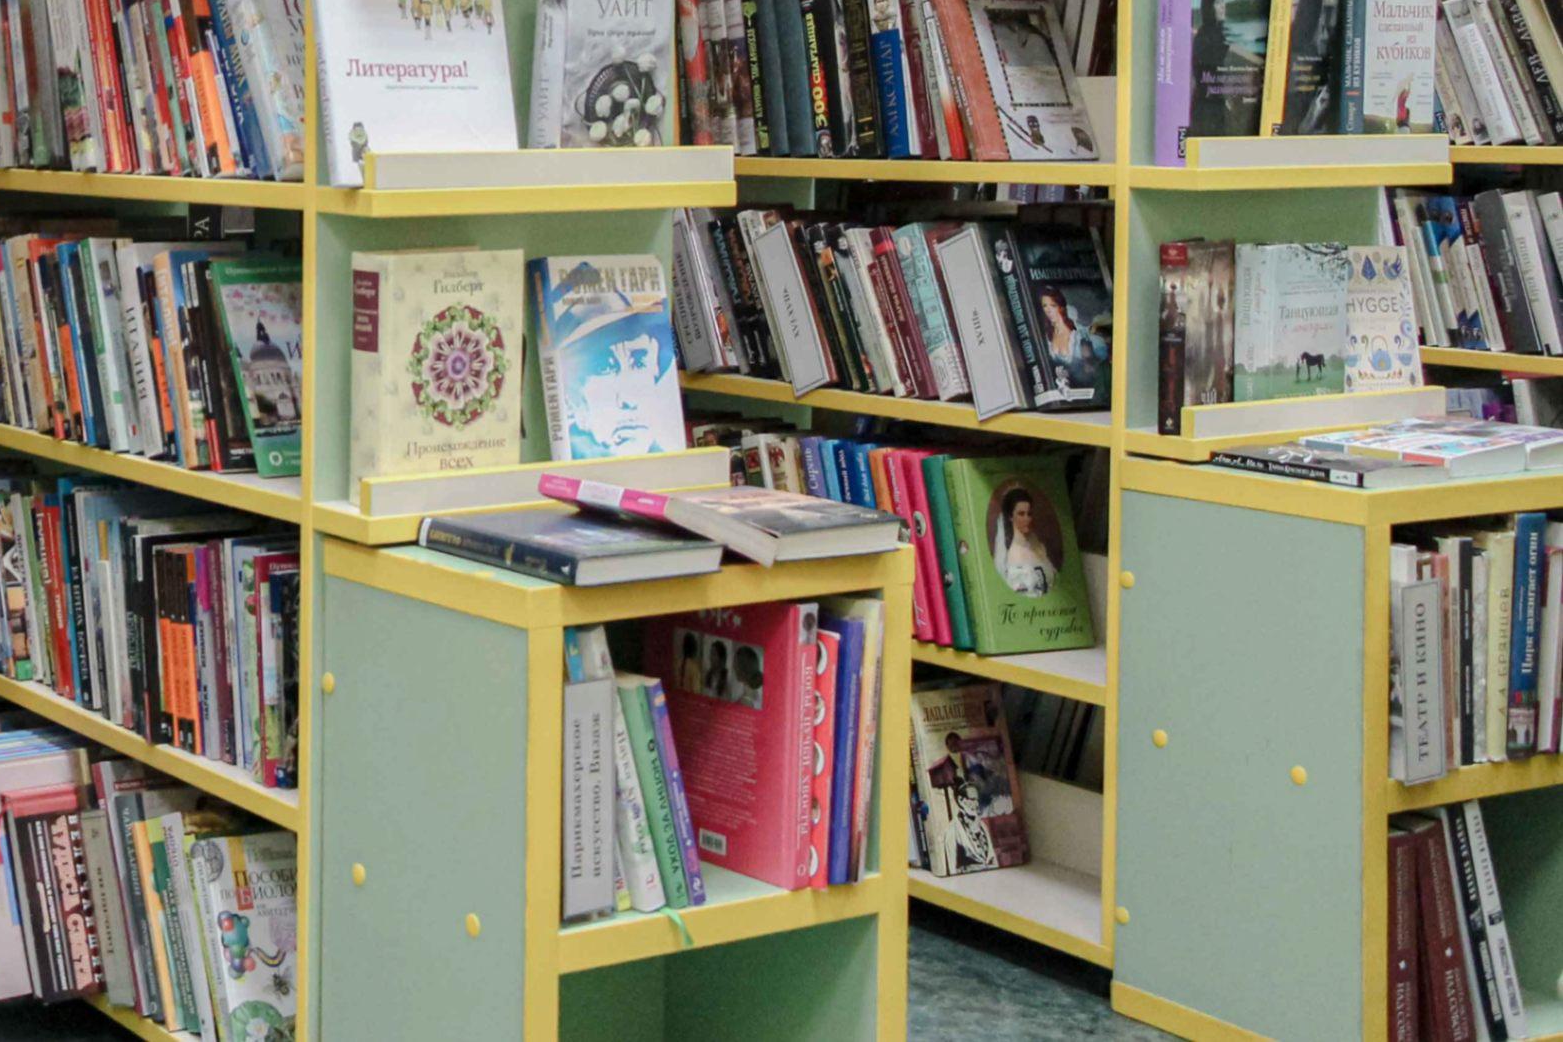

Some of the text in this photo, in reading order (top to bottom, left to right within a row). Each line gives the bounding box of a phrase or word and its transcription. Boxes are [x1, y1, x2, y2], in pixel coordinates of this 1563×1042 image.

[1373, 0, 1434, 19] Мальчик,
[1376, 43, 1431, 61] кубиков
[345, 58, 469, 82] Литература!
[804, 14, 826, 129] 300 СПАРТАНЦЕВ
[432, 278, 486, 297] Гилберт
[620, 264, 660, 291] ГАРИ
[1346, 296, 1399, 314] HYGGE
[543, 355, 564, 443] РОМЕН ГАРИ
[405, 437, 507, 458] Происхождение
[439, 456, 475, 471] всех
